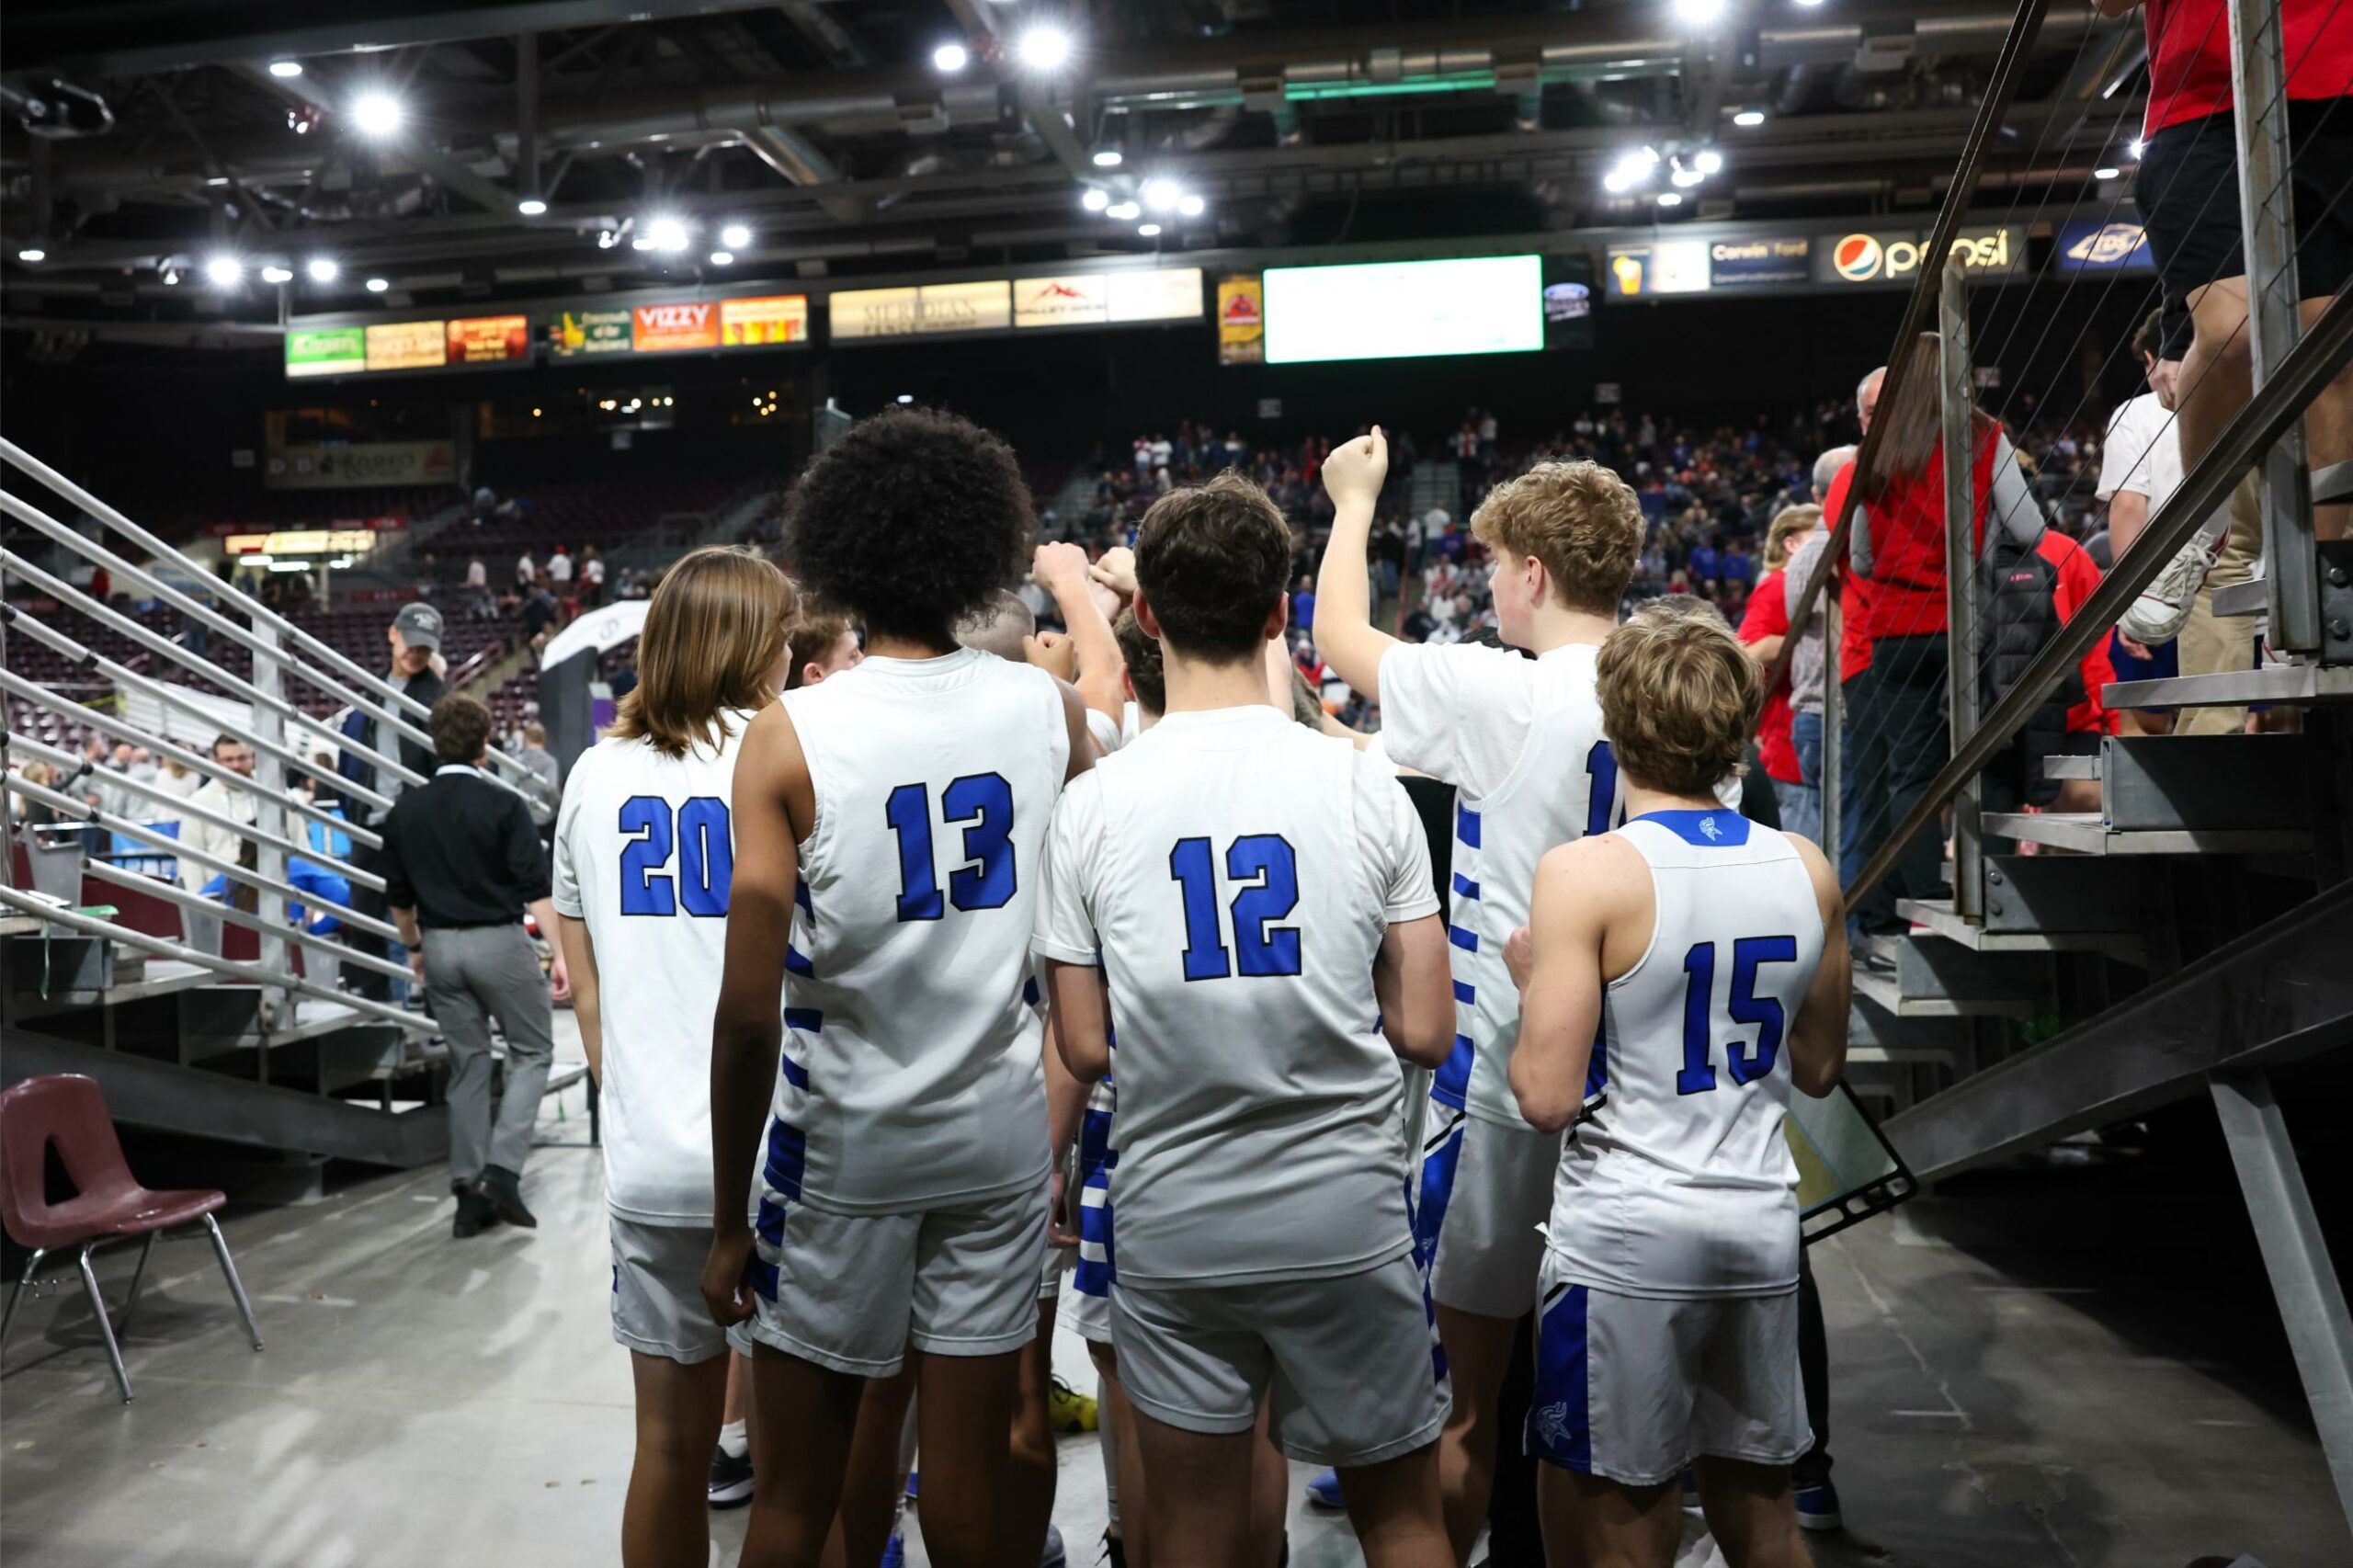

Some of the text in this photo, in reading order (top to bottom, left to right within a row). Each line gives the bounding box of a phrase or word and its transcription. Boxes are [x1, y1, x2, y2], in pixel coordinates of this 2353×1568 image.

[638, 304, 709, 327] VIZZY
[619, 795, 733, 917] 20
[885, 771, 1017, 922] 13
[1169, 834, 1302, 982] 12
[1677, 935, 1797, 1095] 15
